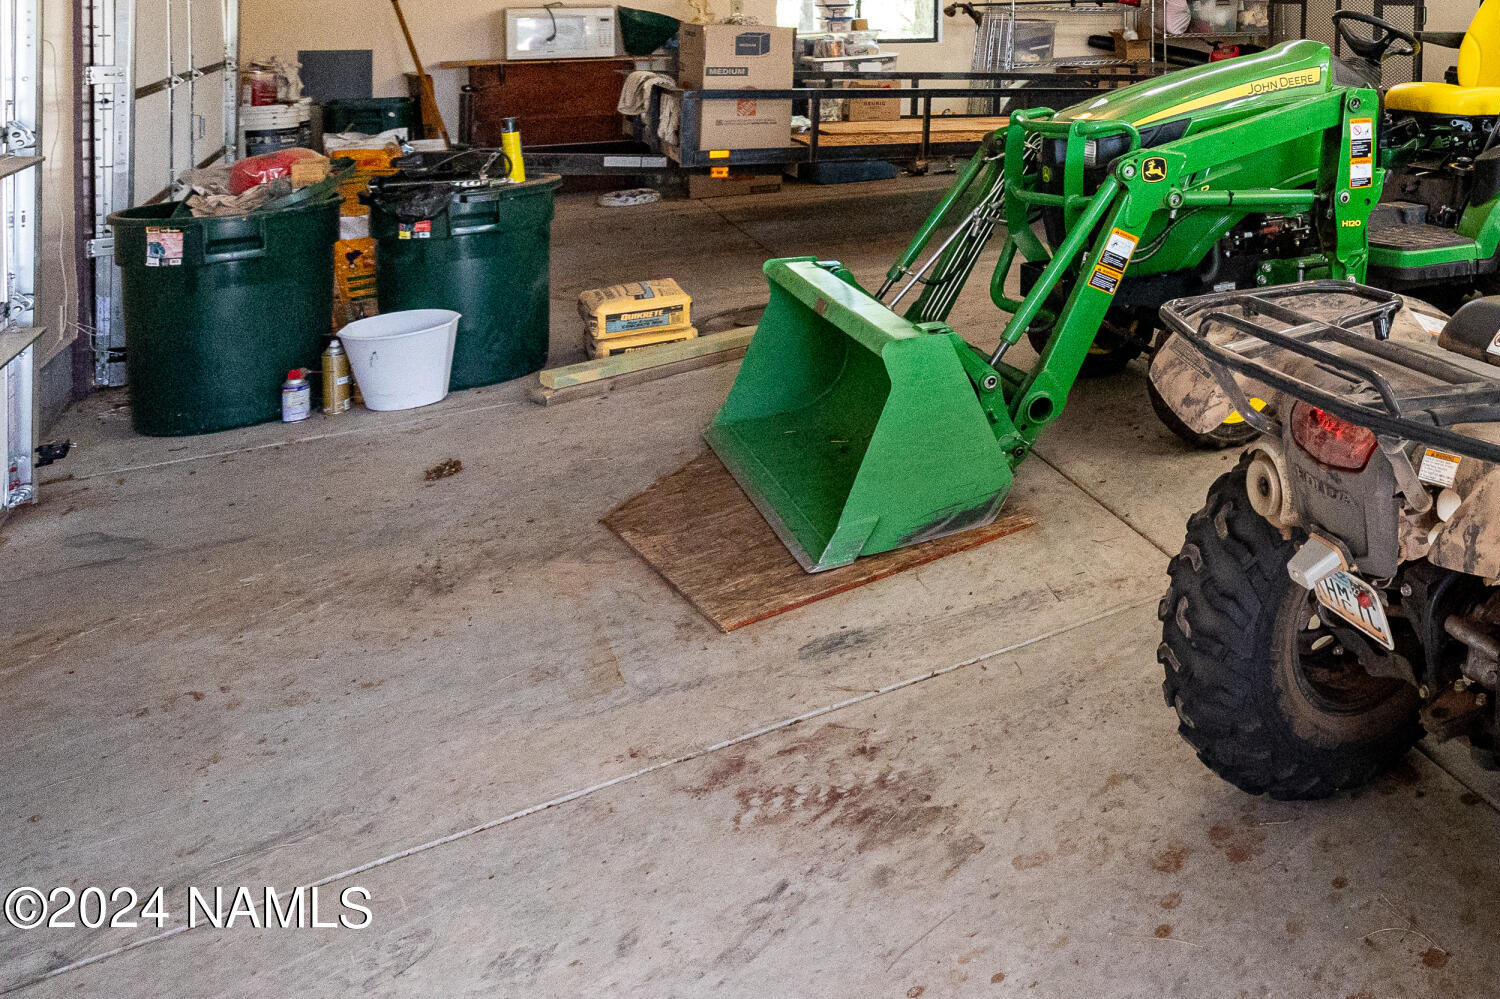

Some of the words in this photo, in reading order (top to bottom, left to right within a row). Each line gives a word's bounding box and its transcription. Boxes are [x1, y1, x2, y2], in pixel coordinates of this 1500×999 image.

[708, 67, 746, 76] MEDIUM
[1247, 80, 1278, 95] JOHN
[1279, 74, 1314, 88] DEERE
[1341, 219, 1362, 228] H120
[620, 310, 665, 321] QUIKRETE
